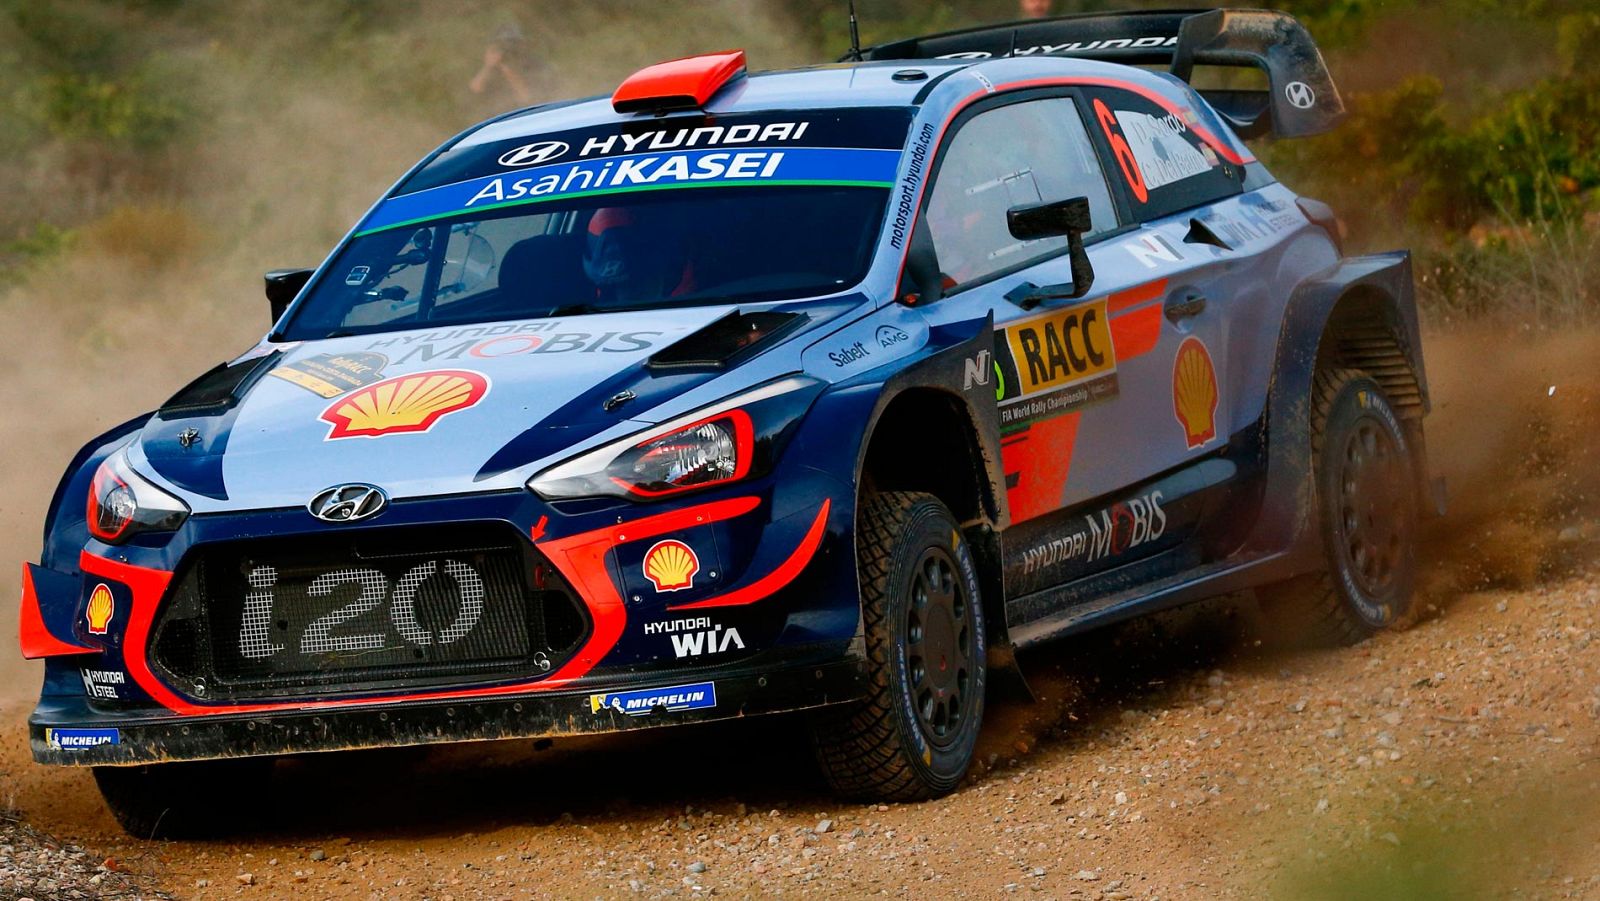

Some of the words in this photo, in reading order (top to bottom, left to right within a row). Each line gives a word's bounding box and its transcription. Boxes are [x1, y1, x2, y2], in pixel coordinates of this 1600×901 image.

[579, 122, 809, 156] HYUNDAI
[1093, 98, 1148, 203] 6
[465, 152, 785, 207] AsahiKASEI
[890, 122, 935, 250] motorsport.hyundai.com
[365, 321, 562, 350] HYUNDAI
[392, 331, 665, 366] MOBIS
[880, 331, 909, 349] AMG
[1019, 308, 1105, 386] RACC
[828, 340, 870, 368] Sabelt
[1002, 410, 1013, 423] FIA
[1012, 404, 1031, 419] World
[1031, 401, 1047, 414] Rally
[1047, 389, 1089, 410] Championship
[1022, 530, 1087, 575] HYUNDAI
[1085, 490, 1167, 563] MOBIS
[644, 616, 711, 635] HYUNDAI
[670, 624, 746, 658] WIA
[91, 670, 125, 684] HYUNDAI
[95, 685, 119, 698] STEEL
[626, 691, 705, 709] MICHELIN
[61, 736, 112, 746] MICHELIN
